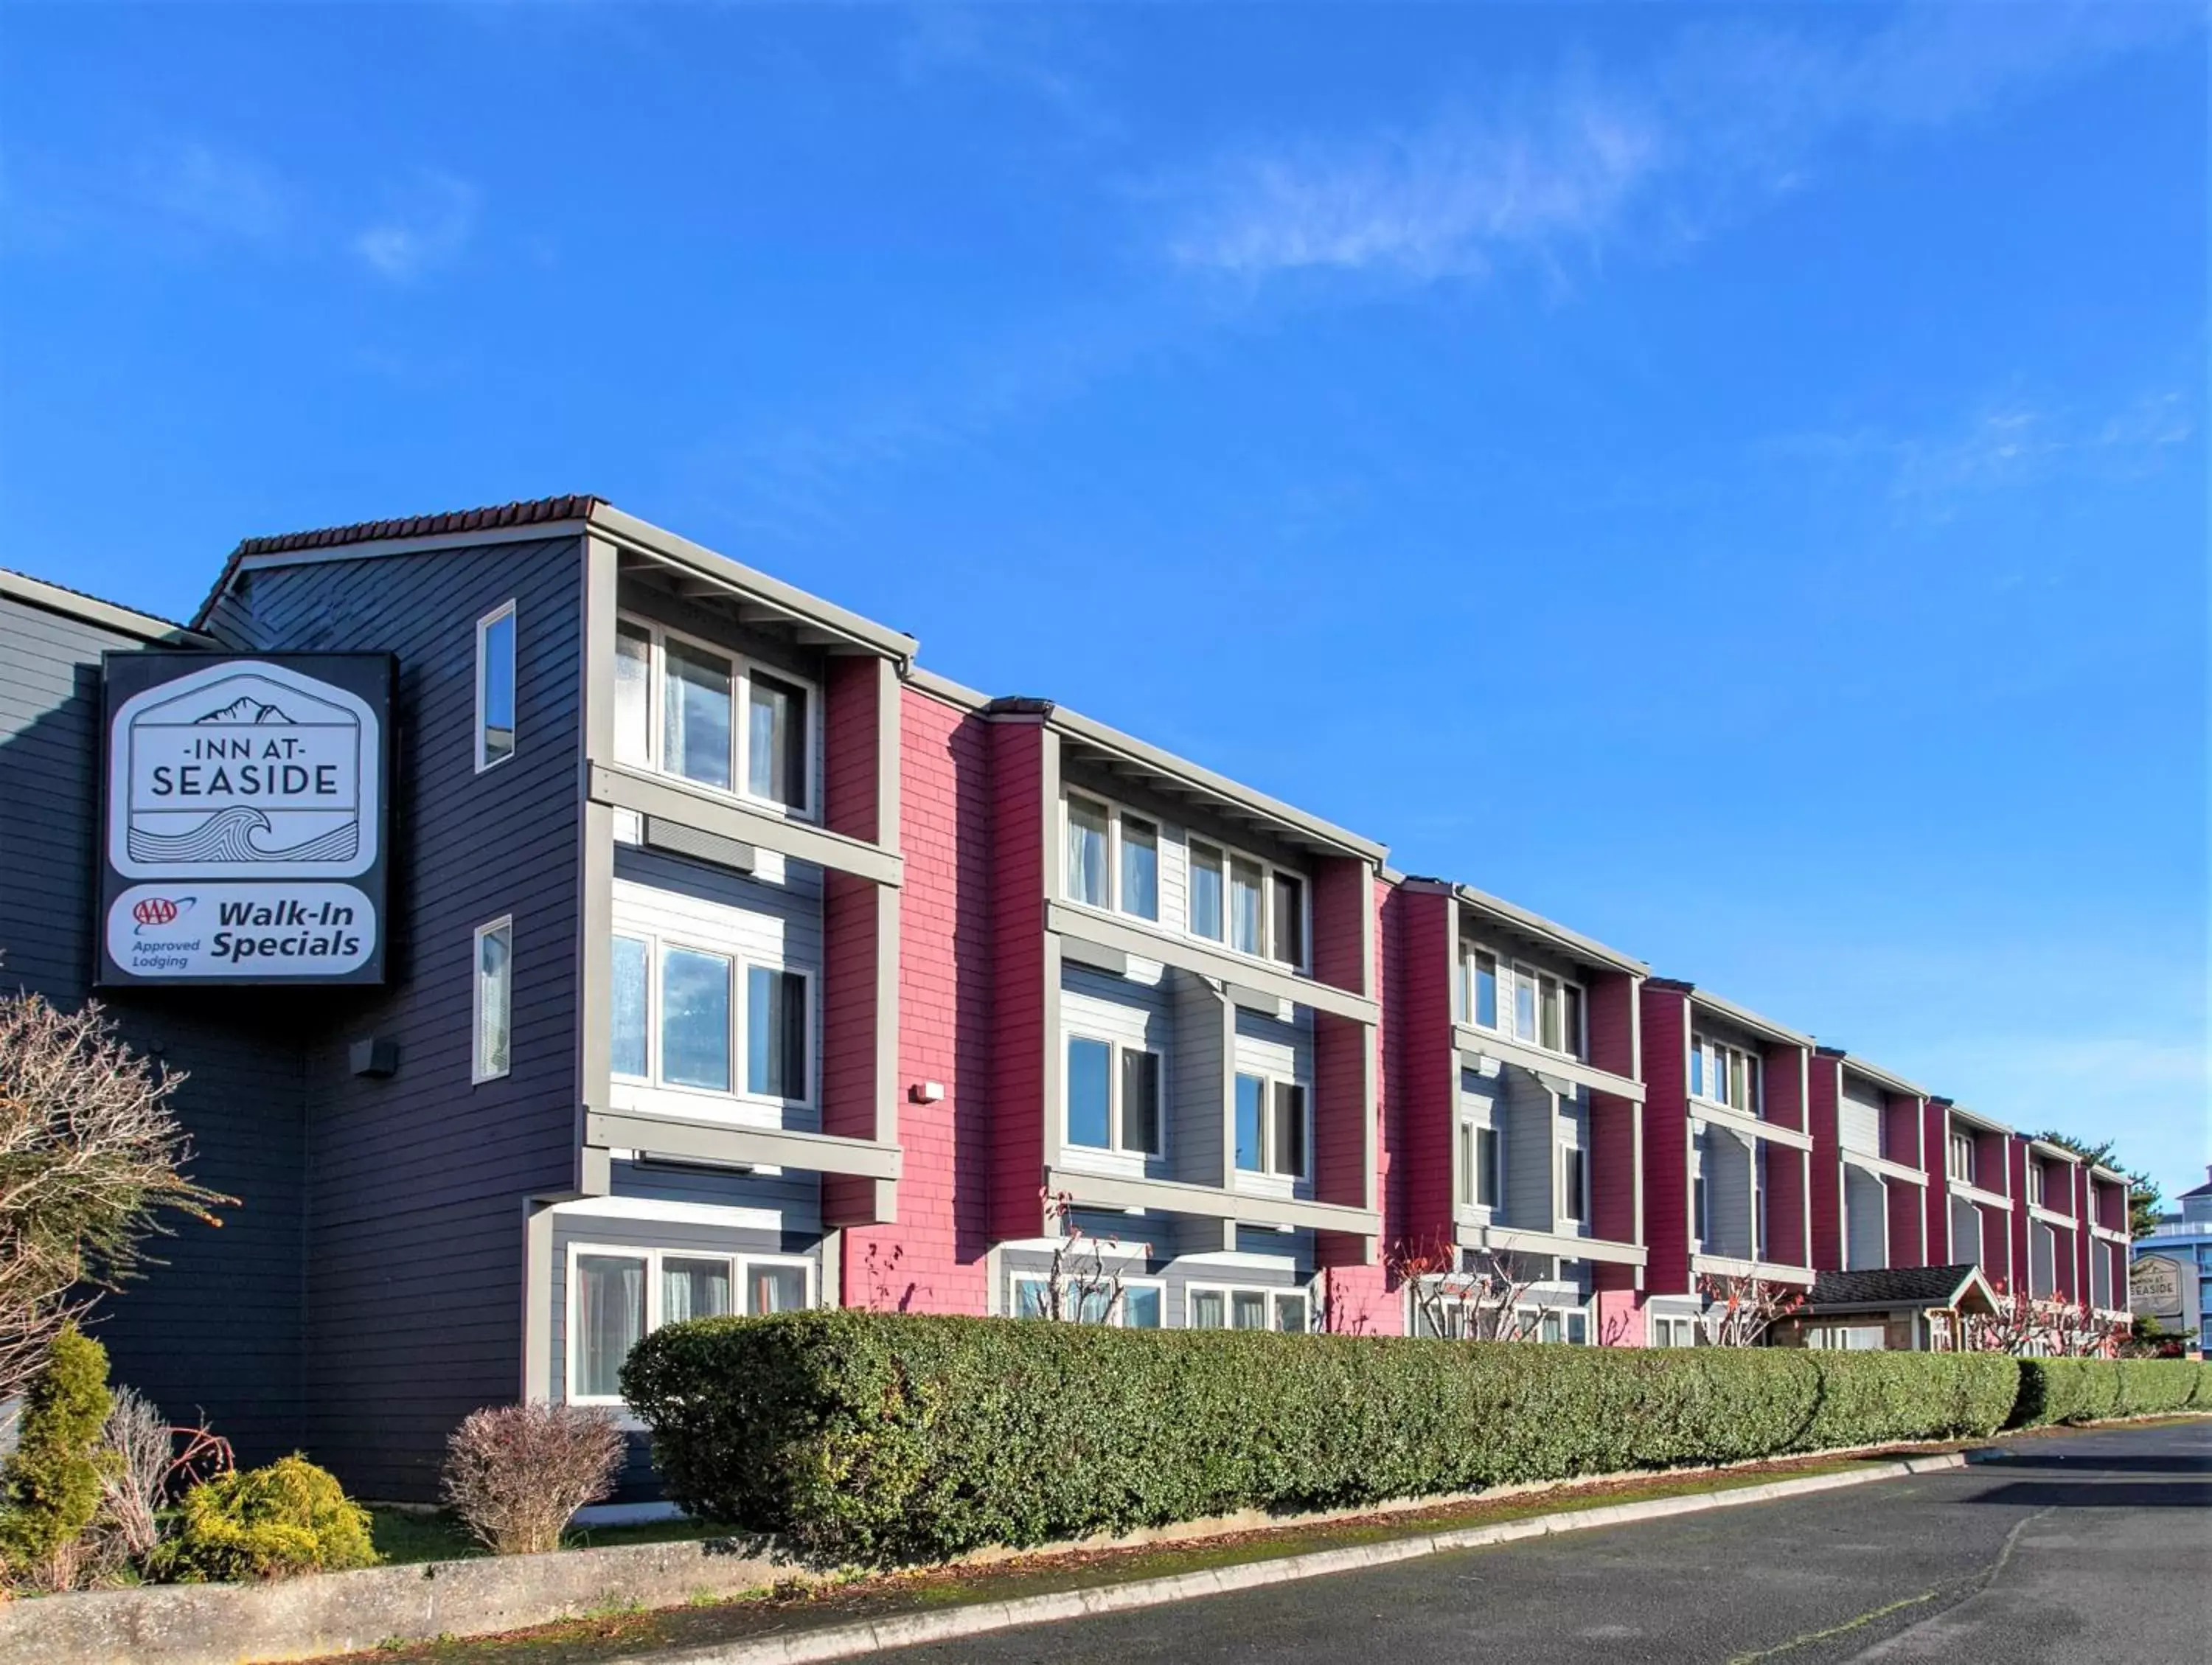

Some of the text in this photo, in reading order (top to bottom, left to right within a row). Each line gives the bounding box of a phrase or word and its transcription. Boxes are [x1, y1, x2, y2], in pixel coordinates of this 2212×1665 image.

[151, 765, 338, 796] SEASIDE
[136, 899, 175, 924] AAA
[220, 900, 354, 927] Walk-In
[132, 939, 201, 954] Approved
[210, 931, 360, 962] Specials
[132, 956, 188, 970] Lodging
